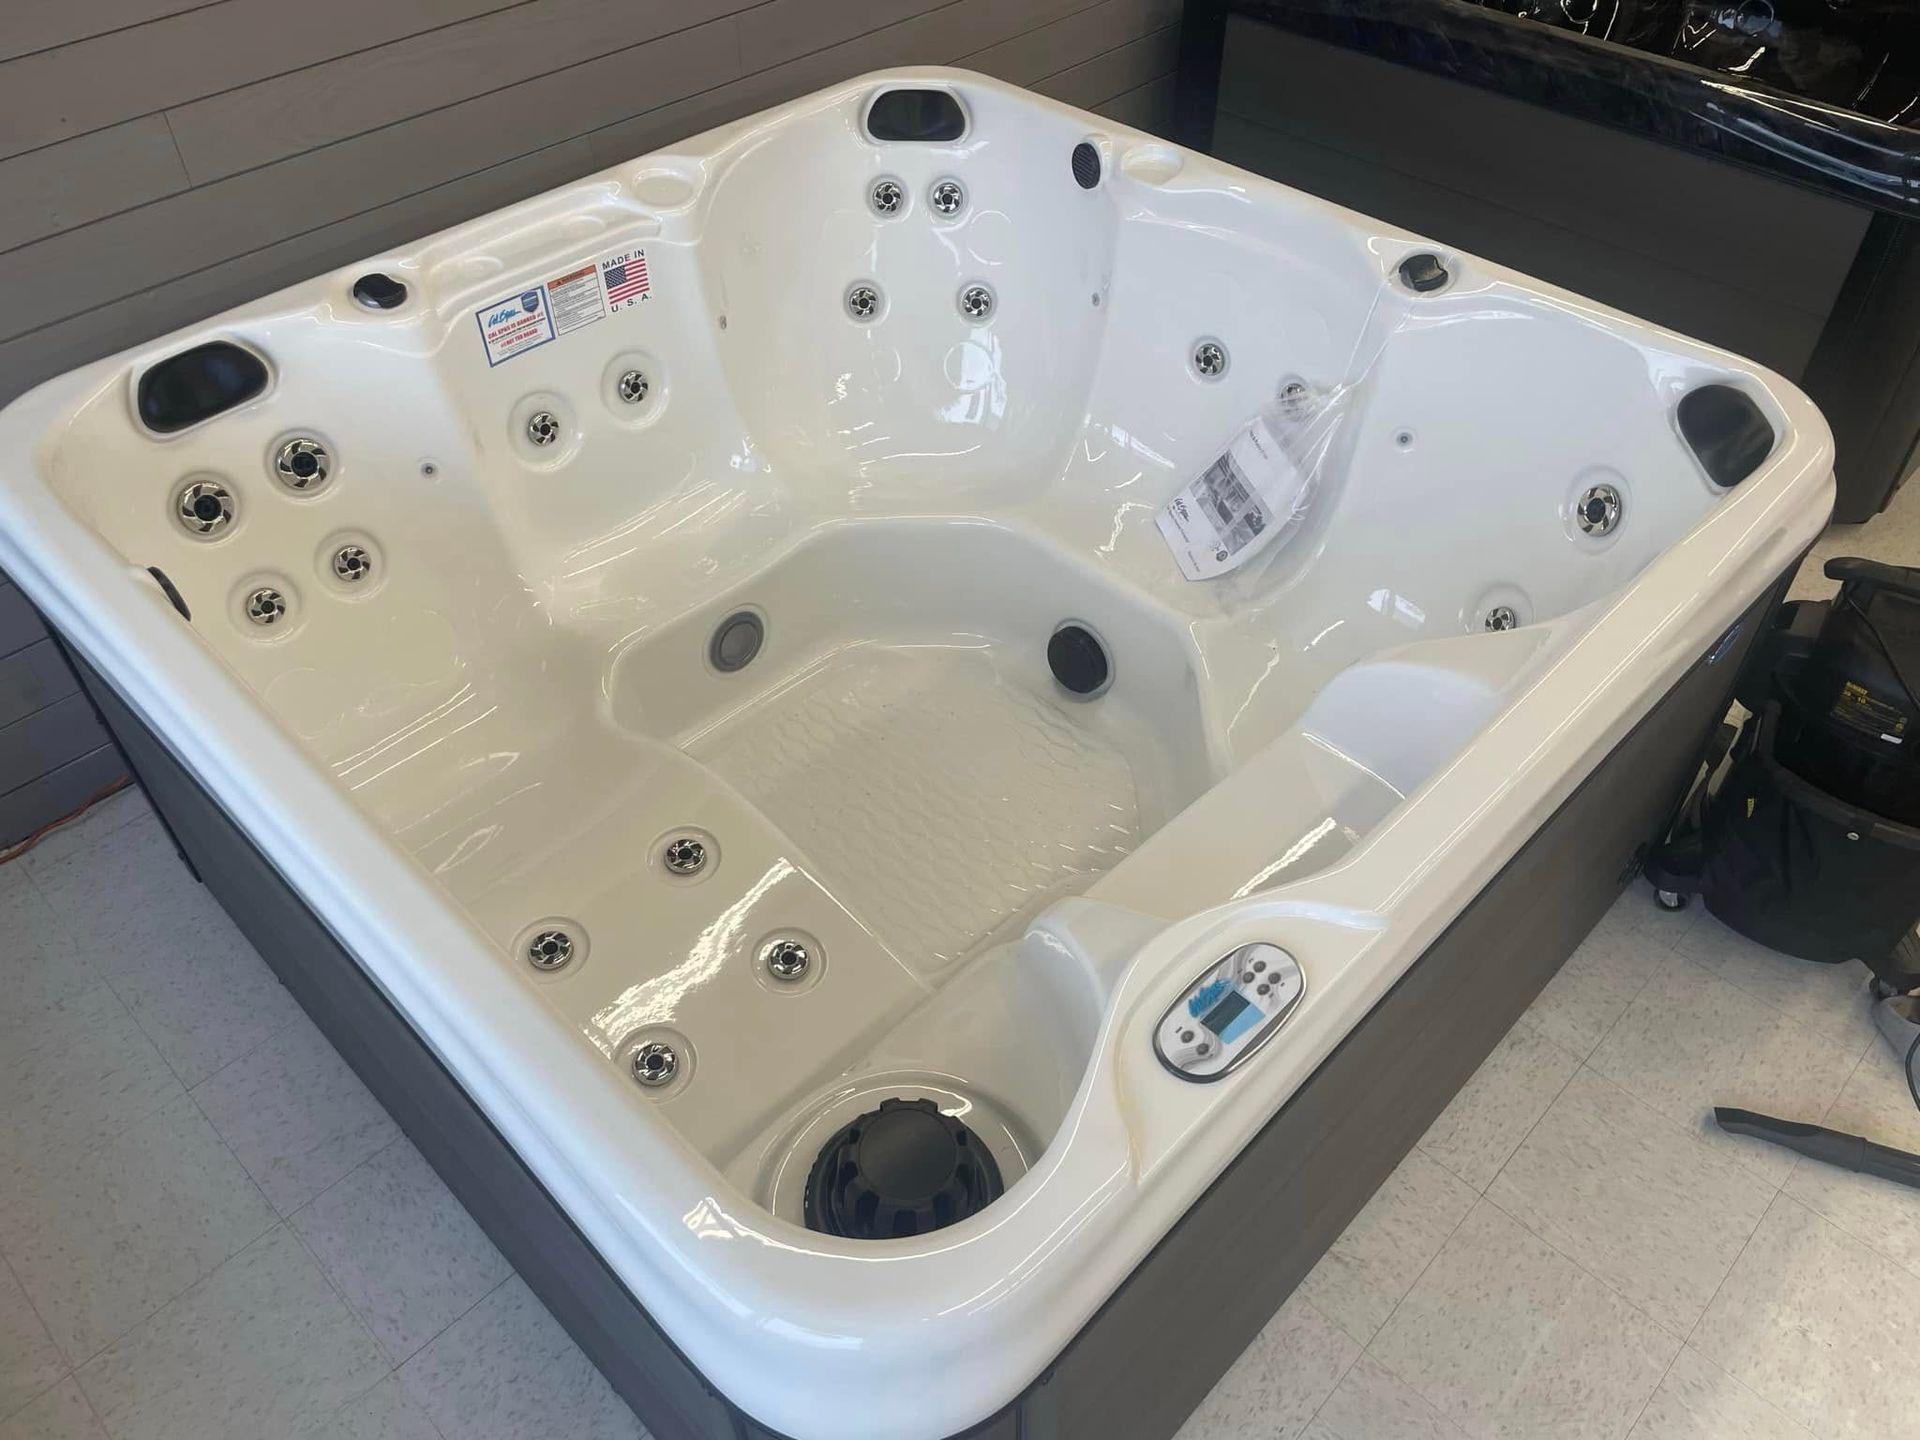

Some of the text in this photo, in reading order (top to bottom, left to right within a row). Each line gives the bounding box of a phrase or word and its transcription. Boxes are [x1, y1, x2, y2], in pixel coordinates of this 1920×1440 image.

[602, 249, 644, 270] MADE IN
[611, 293, 652, 313] U. S. A.
